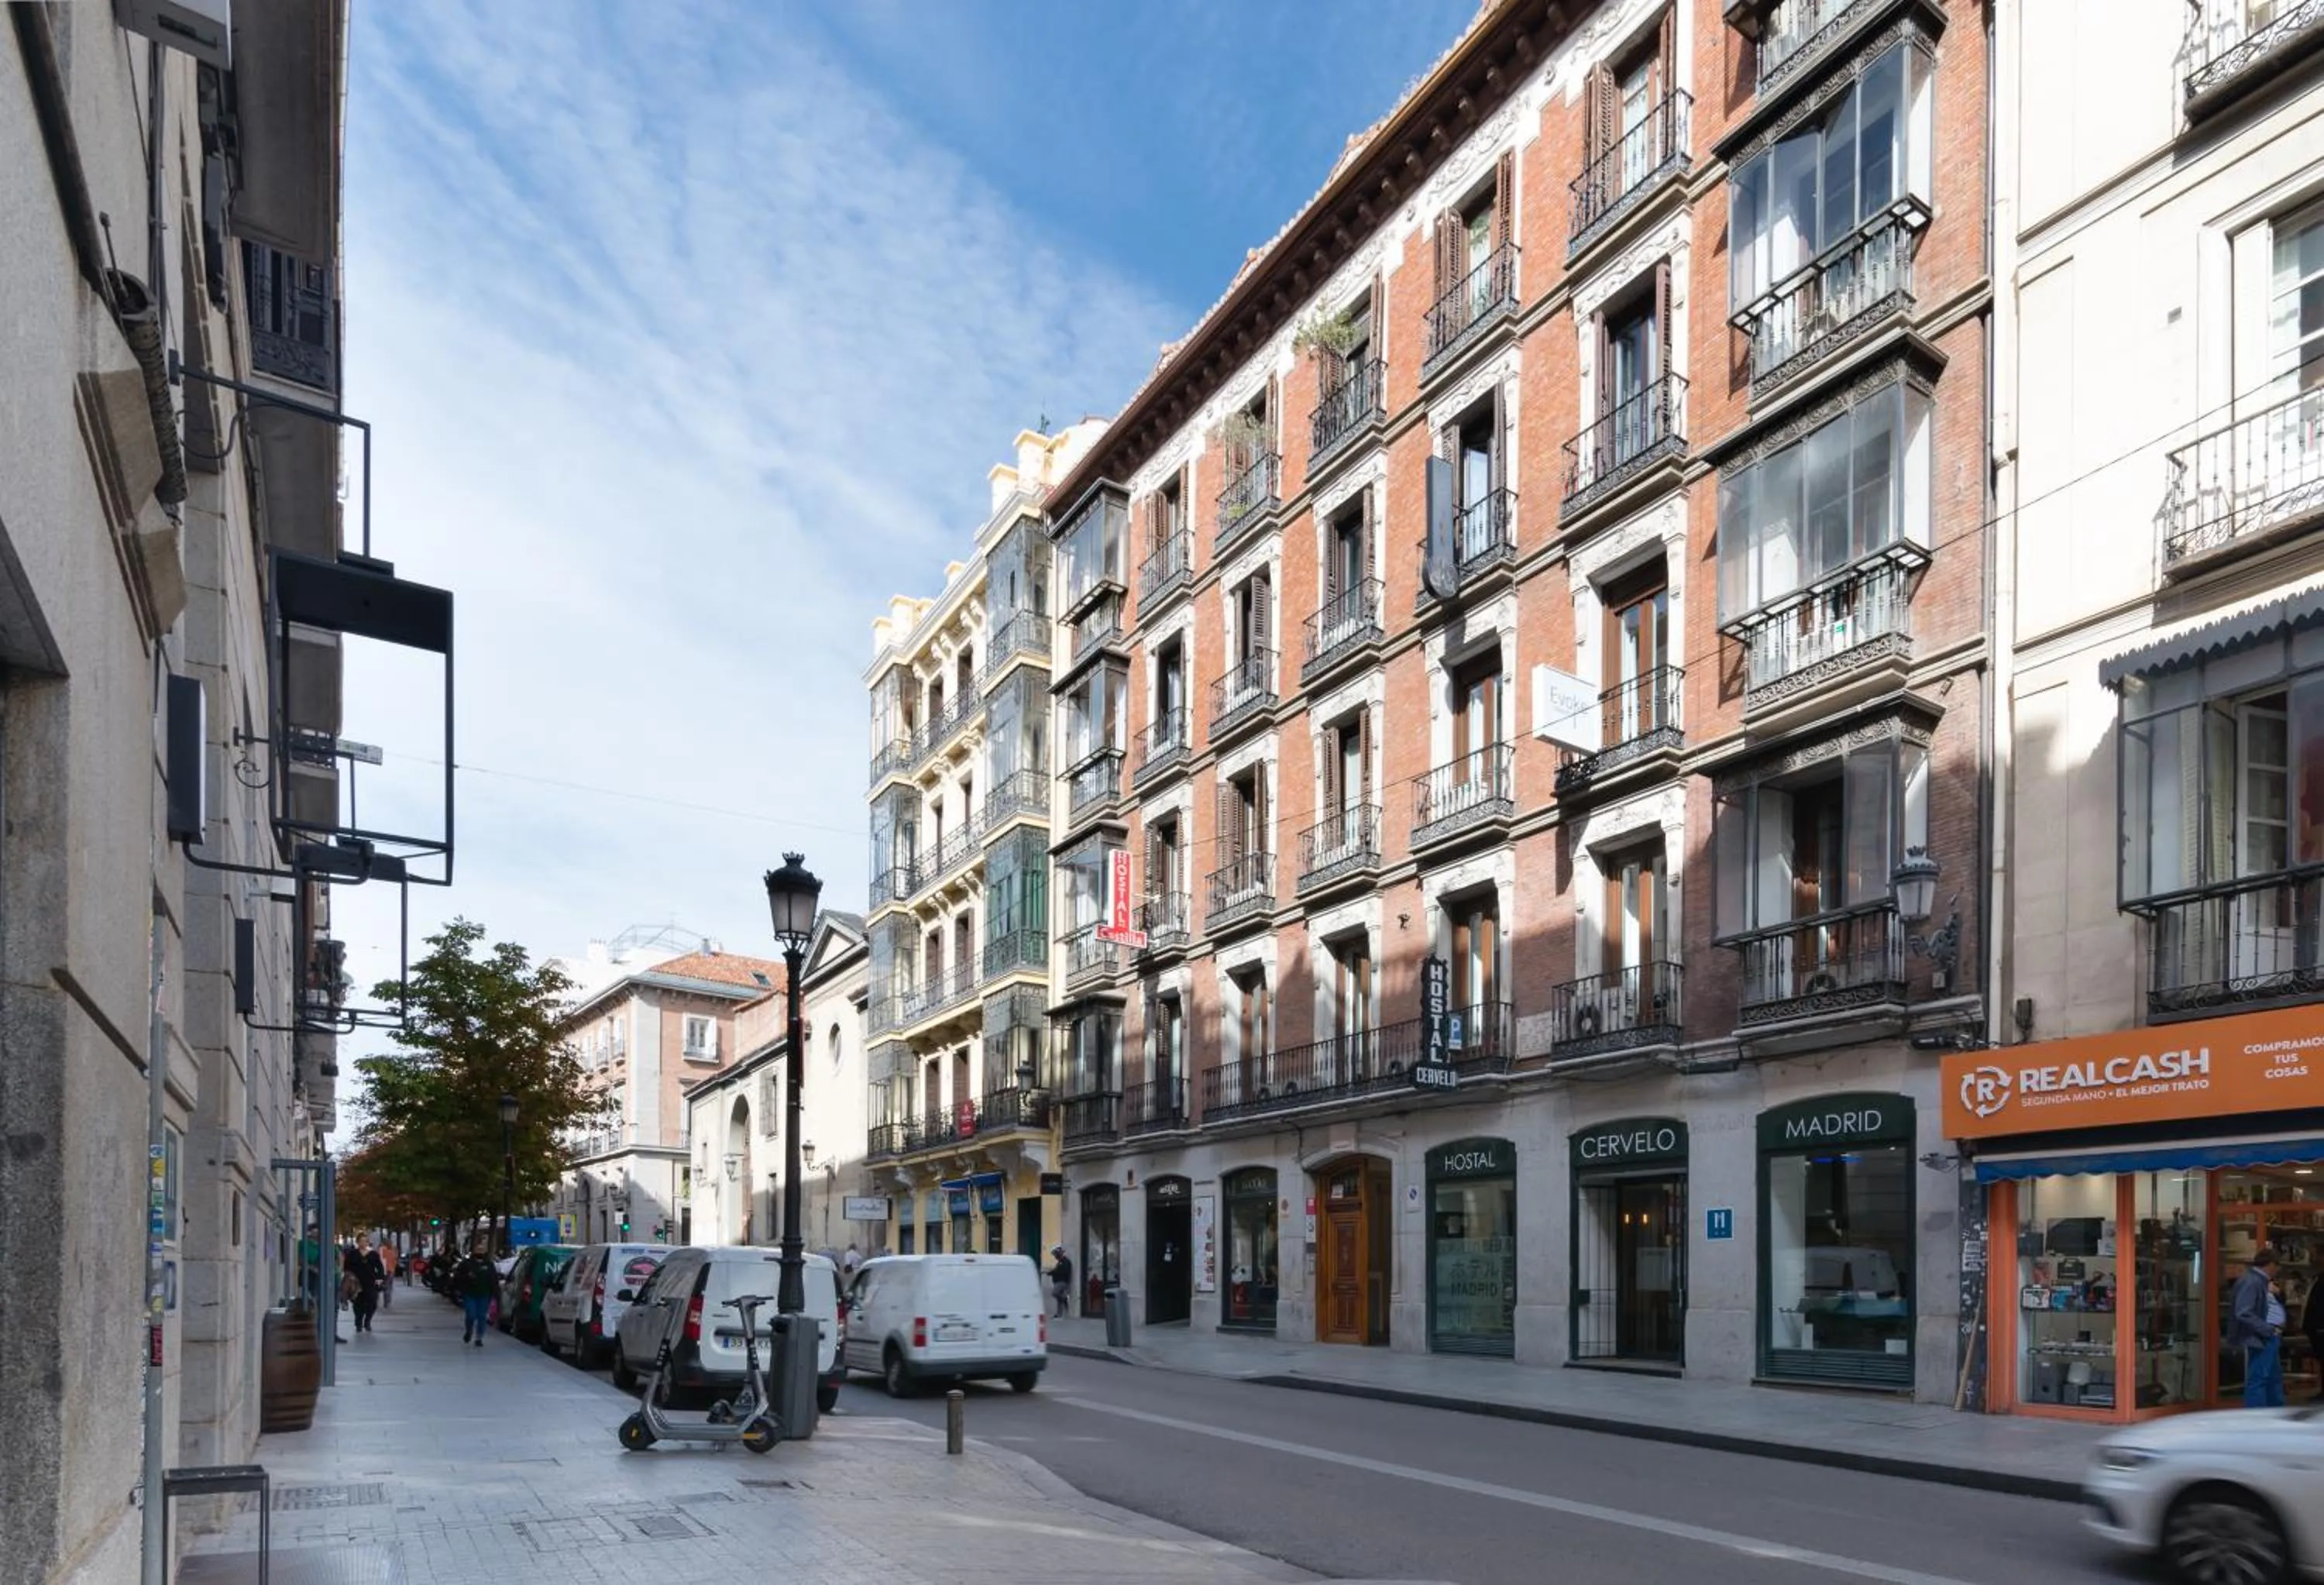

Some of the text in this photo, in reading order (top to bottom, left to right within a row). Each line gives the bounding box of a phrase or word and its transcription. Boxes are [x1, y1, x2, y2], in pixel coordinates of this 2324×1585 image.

[1116, 852, 1128, 923] HOSTAL
[1429, 964, 1443, 1063] HOSTAL
[1451, 1019, 1460, 1039] P
[2020, 1047, 2210, 1094] REALCASH
[2274, 1054, 2299, 1064] TUS
[1416, 1067, 1456, 1086] CERVELO
[2265, 1066, 2308, 1078] COSAS
[1977, 1078, 1994, 1102] R
[2021, 1079, 2209, 1107] SEGUNDA MANO EL MEJOR TRATO
[1786, 1110, 1882, 1139] MADRID
[1581, 1128, 1675, 1157] CERVELO
[1445, 1152, 1497, 1171] HOSTAL
[1451, 1282, 1498, 1297] MADRID
